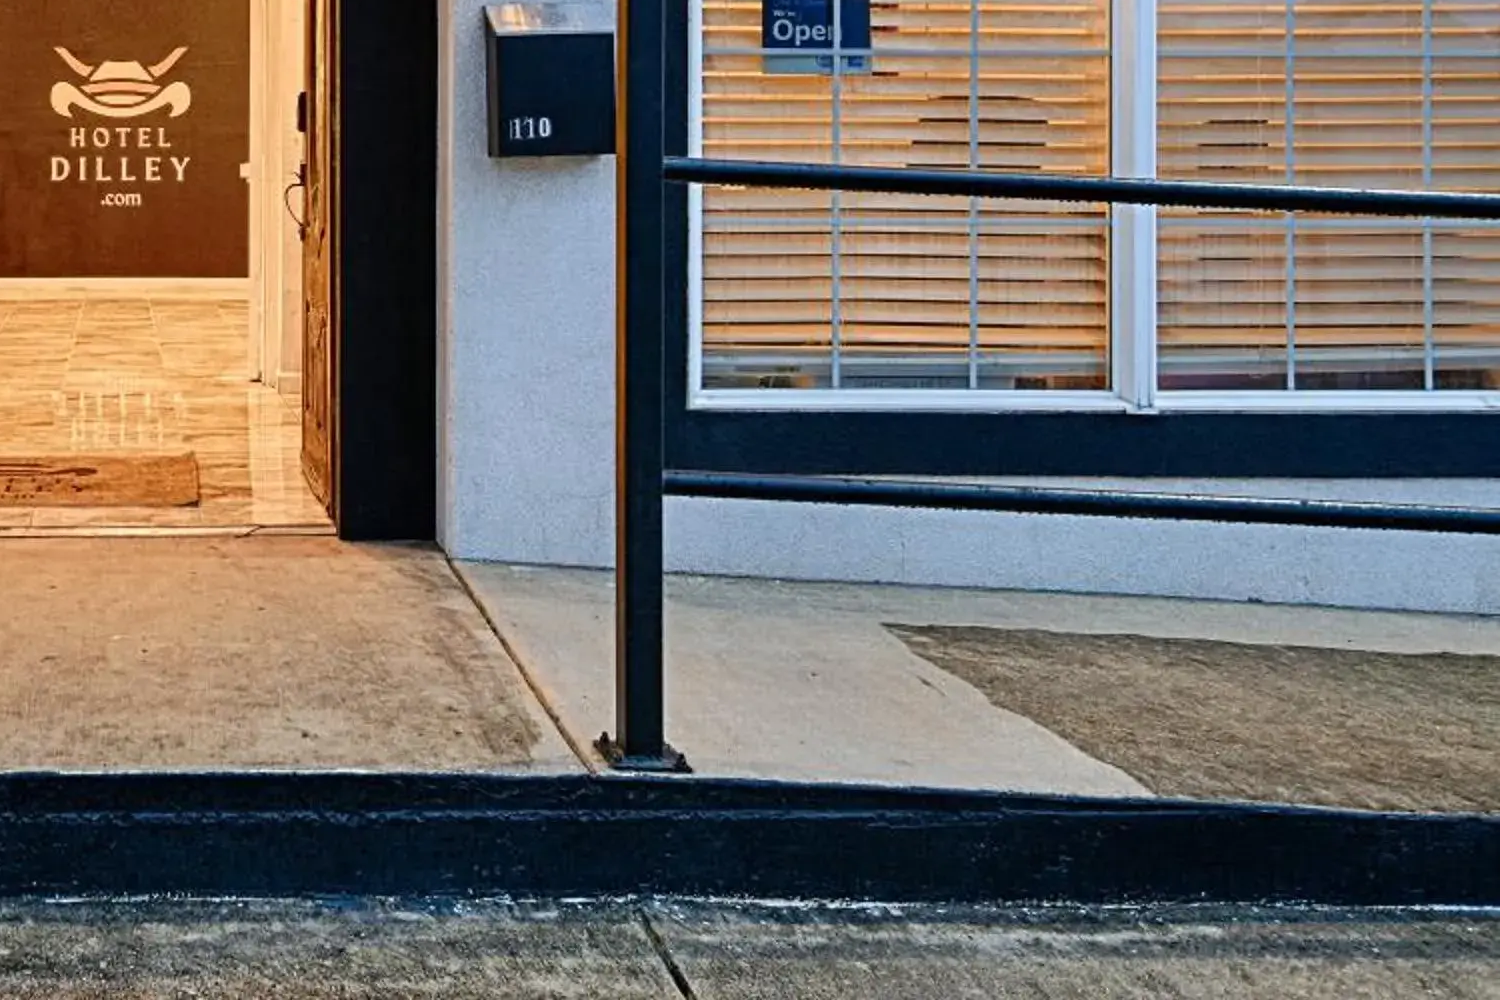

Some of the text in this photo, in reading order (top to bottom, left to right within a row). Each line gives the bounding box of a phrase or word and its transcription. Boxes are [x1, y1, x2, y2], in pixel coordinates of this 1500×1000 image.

[772, 19, 842, 46] Open
[69, 127, 172, 148] HOTEL
[512, 117, 552, 139] 110
[50, 156, 191, 182] DILLEY
[100, 192, 142, 207] .com
